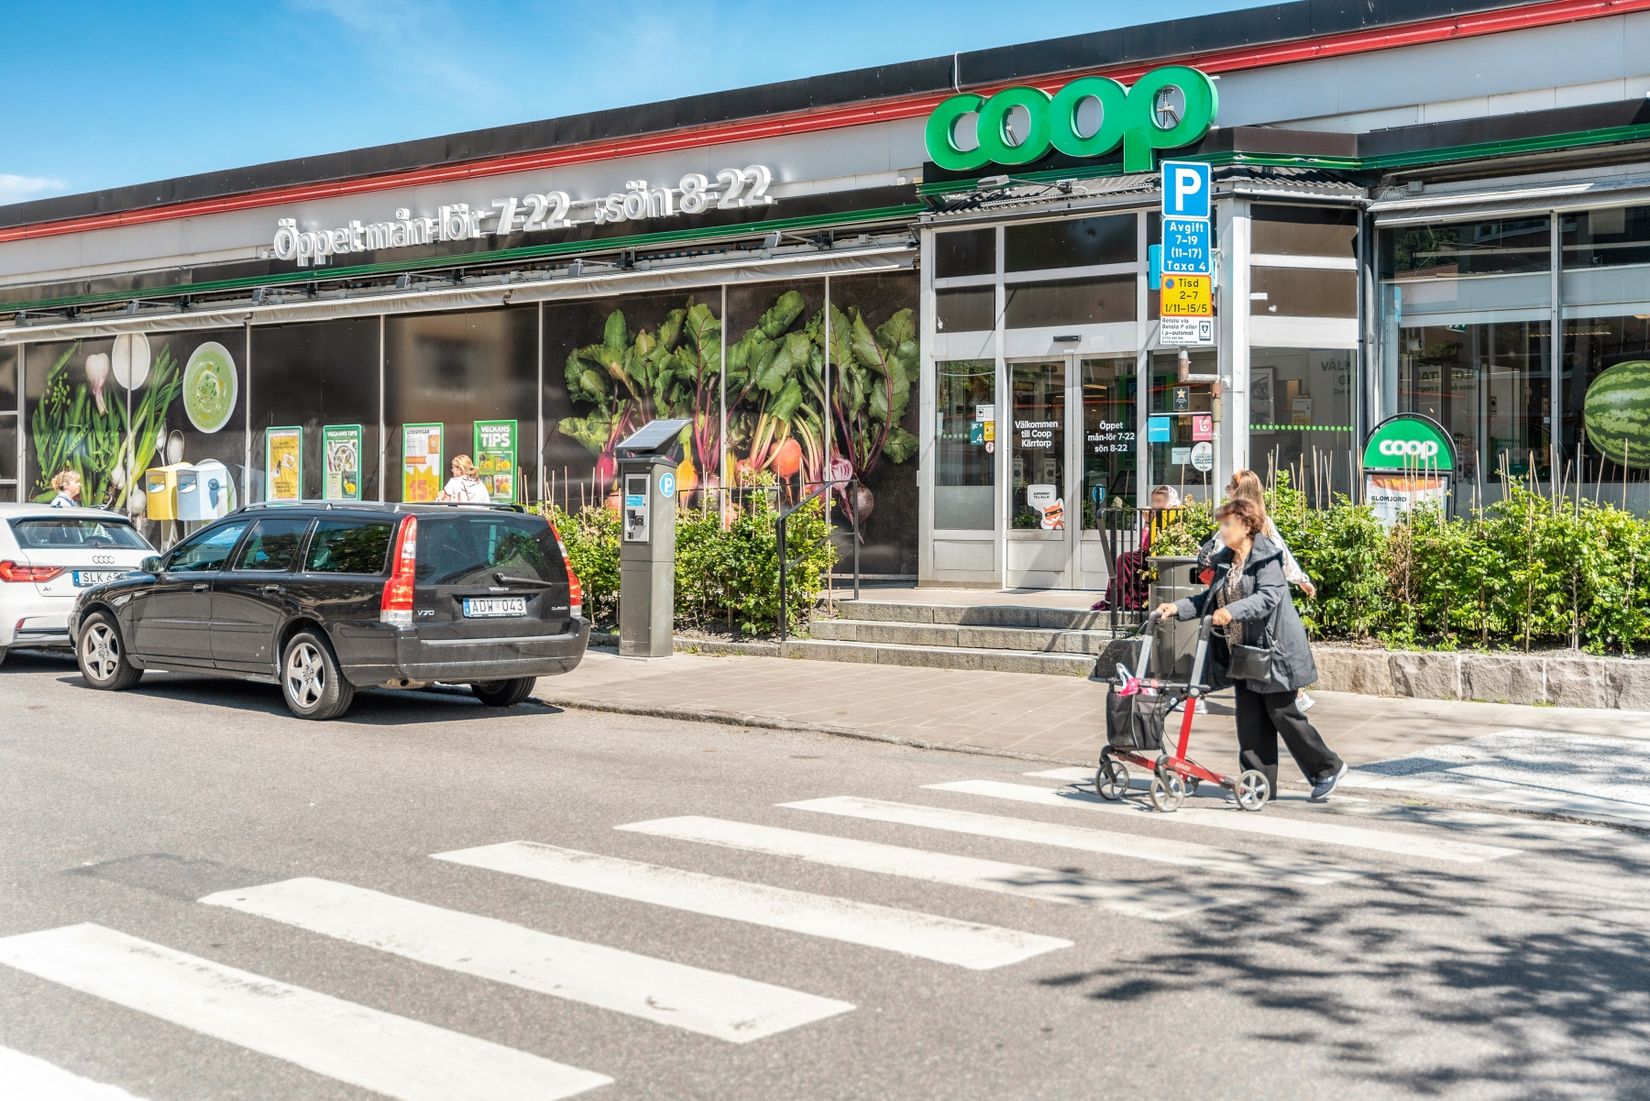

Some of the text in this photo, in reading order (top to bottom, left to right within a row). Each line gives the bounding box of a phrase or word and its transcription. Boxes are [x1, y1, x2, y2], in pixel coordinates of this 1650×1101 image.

[924, 65, 1218, 174] coop
[1176, 168, 1202, 212] P
[273, 218, 364, 267] Öppet
[365, 203, 485, 250] mån-lör
[492, 190, 573, 235] 7-22
[679, 165, 777, 214] 8-22
[1170, 222, 1204, 234] Avgift
[1176, 235, 1198, 246] 7-19
[1171, 246, 1202, 259] (11-17)
[1167, 261, 1206, 272] Taxa 4
[1179, 278, 1199, 288] Tisd
[1180, 291, 1198, 300] 2-7
[1165, 304, 1208, 313] 1/11-15/5
[1015, 420, 1058, 429] Välkommen
[1100, 420, 1124, 430] Öppet
[976, 434, 983, 442] 4
[1032, 430, 1052, 439] Coop
[1088, 432, 1135, 441] mån-lör 7-22
[482, 434, 510, 448] TIPS
[1022, 439, 1052, 448] Kärrtorp
[1094, 444, 1128, 452] sön 8-22
[1380, 440, 1438, 460] coop
[664, 478, 672, 493] P
[83, 572, 104, 582] SLK
[472, 600, 523, 612] ADW 043
